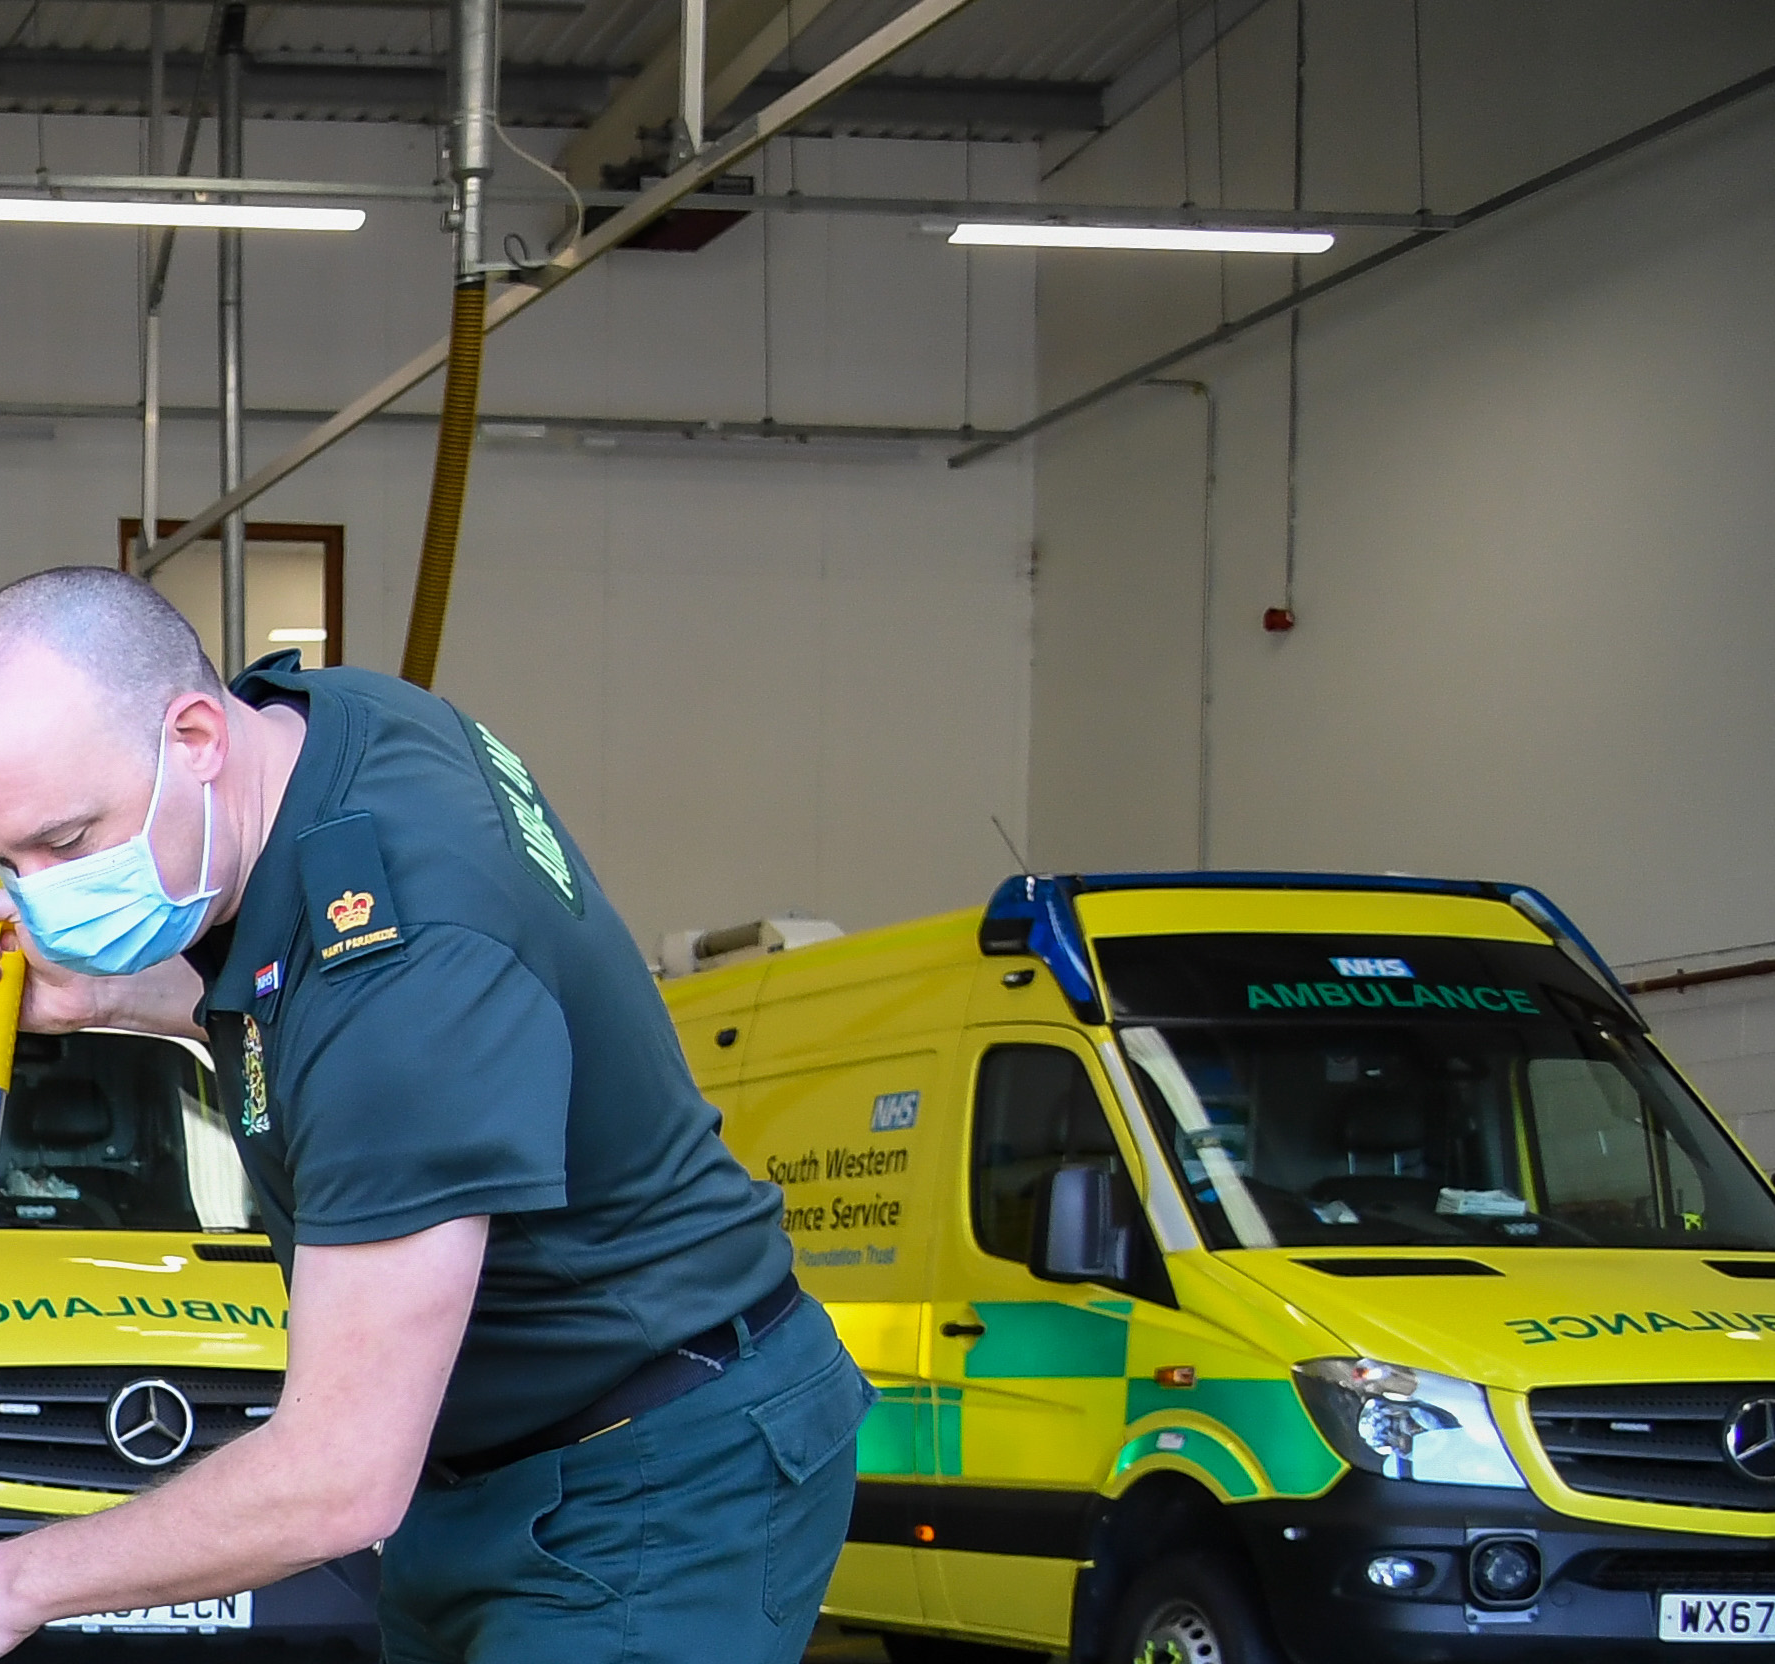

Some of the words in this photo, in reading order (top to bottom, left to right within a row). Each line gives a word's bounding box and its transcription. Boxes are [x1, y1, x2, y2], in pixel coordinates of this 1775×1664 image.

[345, 926, 398, 951] PARAMEDIC
[1338, 957, 1408, 977] NHS
[1247, 981, 1541, 1015] AMBULANCE
[873, 1092, 918, 1129] NHS
[766, 1149, 819, 1185] South
[826, 1146, 909, 1180] Western
[781, 1204, 825, 1232] ance
[830, 1192, 902, 1230] Service
[1680, 1600, 1775, 1634] WX67
